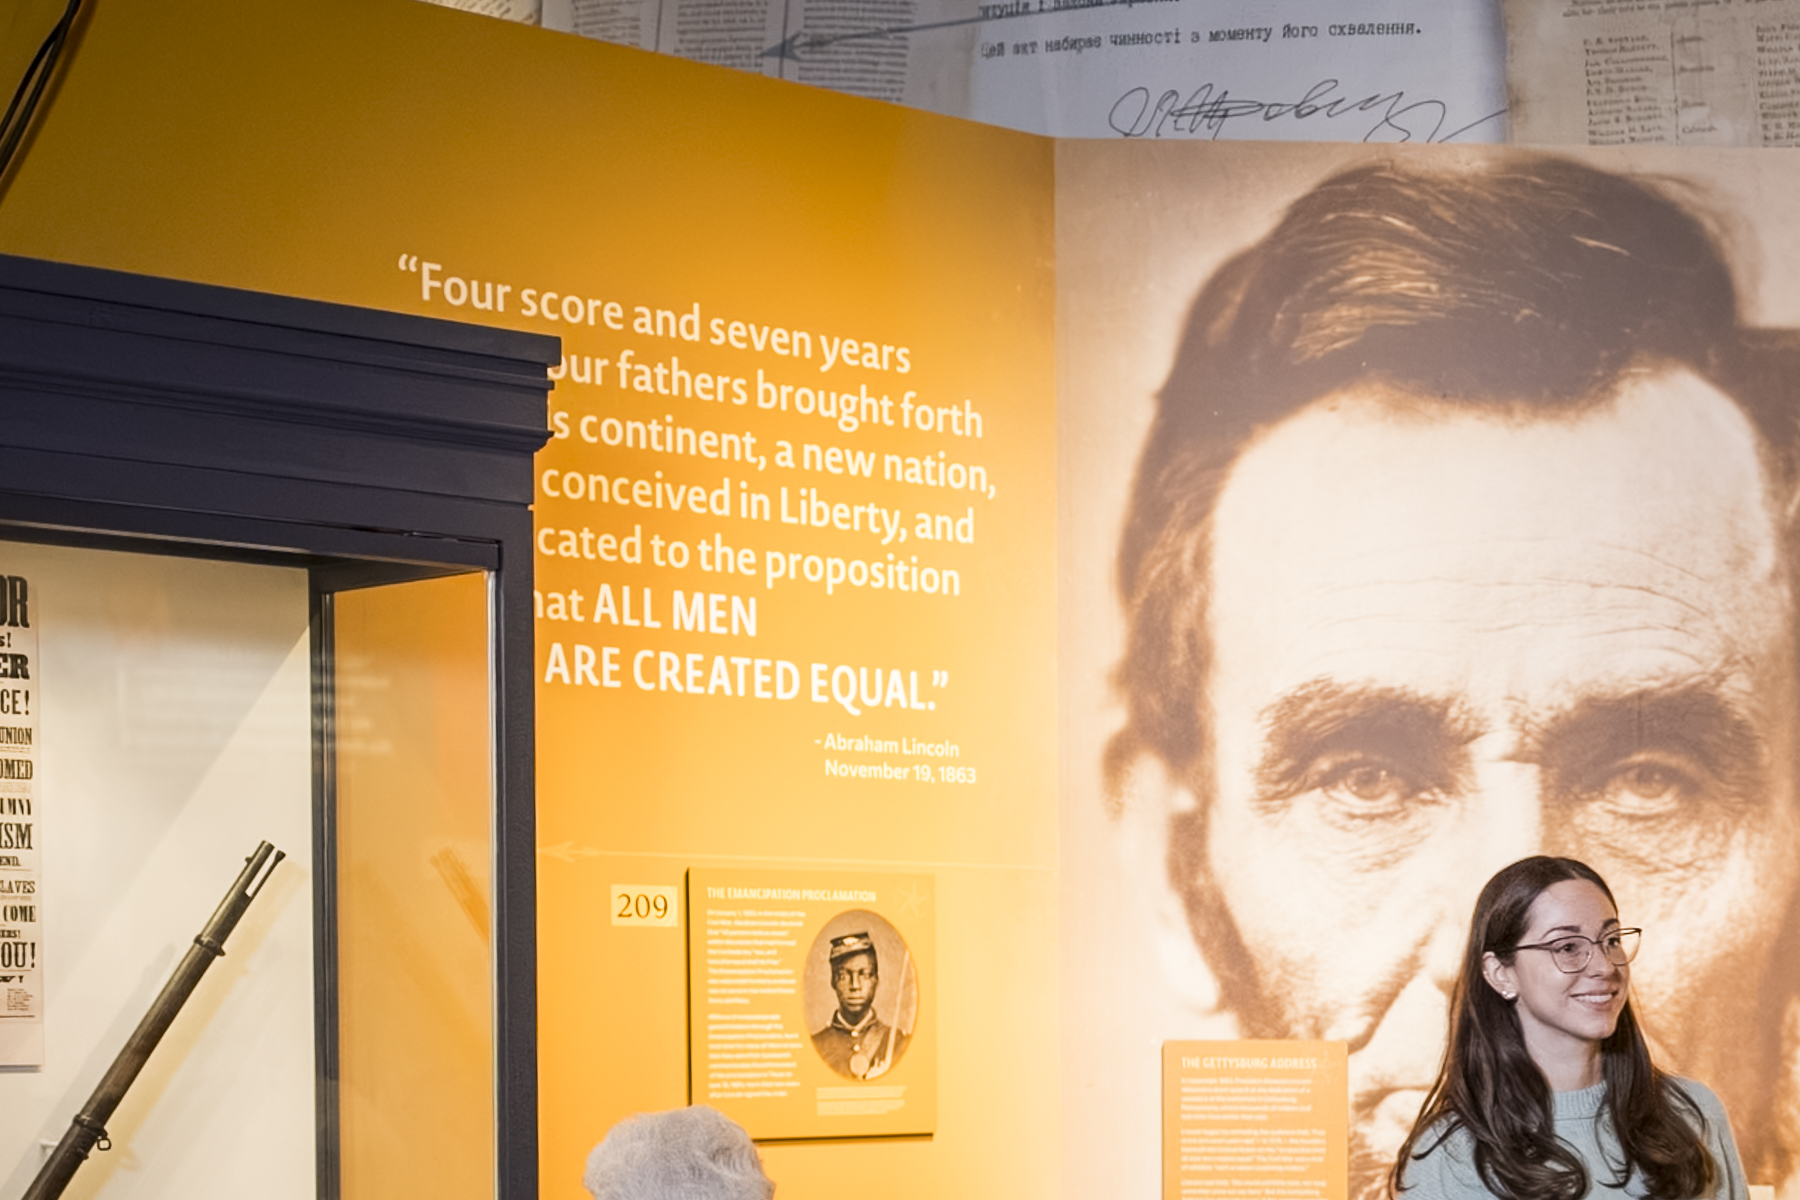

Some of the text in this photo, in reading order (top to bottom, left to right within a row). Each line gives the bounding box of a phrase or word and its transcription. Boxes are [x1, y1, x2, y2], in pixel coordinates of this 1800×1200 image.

[1209, 26, 1272, 42] моменту
[399, 254, 910, 373] “Four score and seven years
[617, 350, 747, 405] fathers
[758, 369, 894, 432] brought
[901, 391, 982, 438] forth
[581, 415, 766, 471] continent,
[775, 441, 795, 468] a
[804, 444, 875, 477] new
[885, 451, 995, 499] nation,
[543, 470, 974, 545] conceived in Liberty, and
[538, 525, 960, 596] cated to the proposition
[594, 584, 661, 628] ALL
[673, 591, 756, 636] MEN
[545, 643, 948, 715] ARE CREATED EQUAL.”
[824, 733, 898, 753] Abraham
[902, 737, 959, 758] Lincoln
[825, 759, 976, 784] November 19, 1863
[617, 893, 668, 919] 209
[707, 887, 876, 902] THE EMANCIPATION PROCLAMATION
[0, 941, 36, 968] OU!
[1182, 1057, 1317, 1069] THE GETTYSBURG ADDRESS
